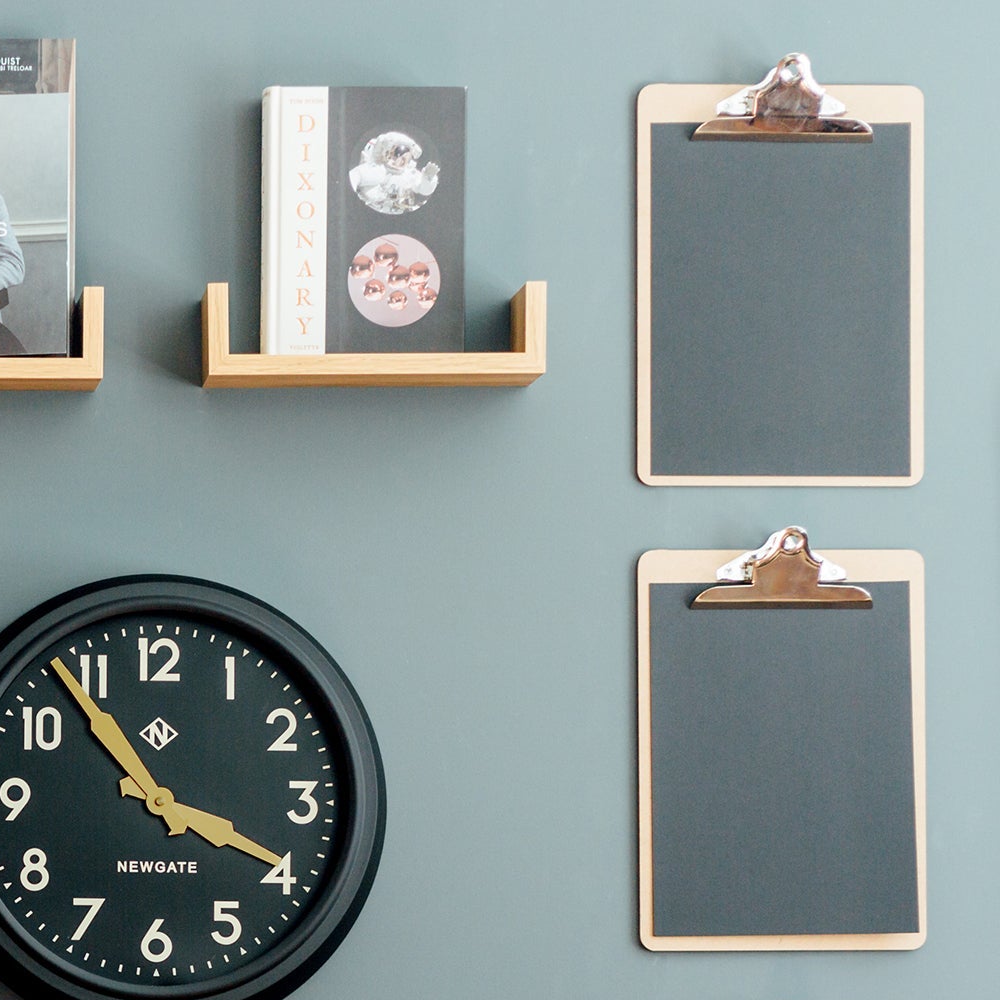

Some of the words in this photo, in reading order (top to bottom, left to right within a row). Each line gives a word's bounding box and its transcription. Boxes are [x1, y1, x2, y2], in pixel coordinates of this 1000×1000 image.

[295, 113, 316, 336] DIXONARY
[80, 654, 108, 699] 11
[138, 638, 180, 681] 12
[225, 657, 235, 700] 1
[23, 707, 61, 750] 10
[266, 708, 297, 751] 2
[0, 778, 31, 821] 9
[287, 781, 318, 824] 3
[20, 848, 49, 891] 8
[118, 861, 197, 873] NEWGATE
[260, 851, 296, 895] 4
[71, 898, 105, 940] 7
[141, 919, 172, 962] 6
[211, 901, 242, 945] 5
